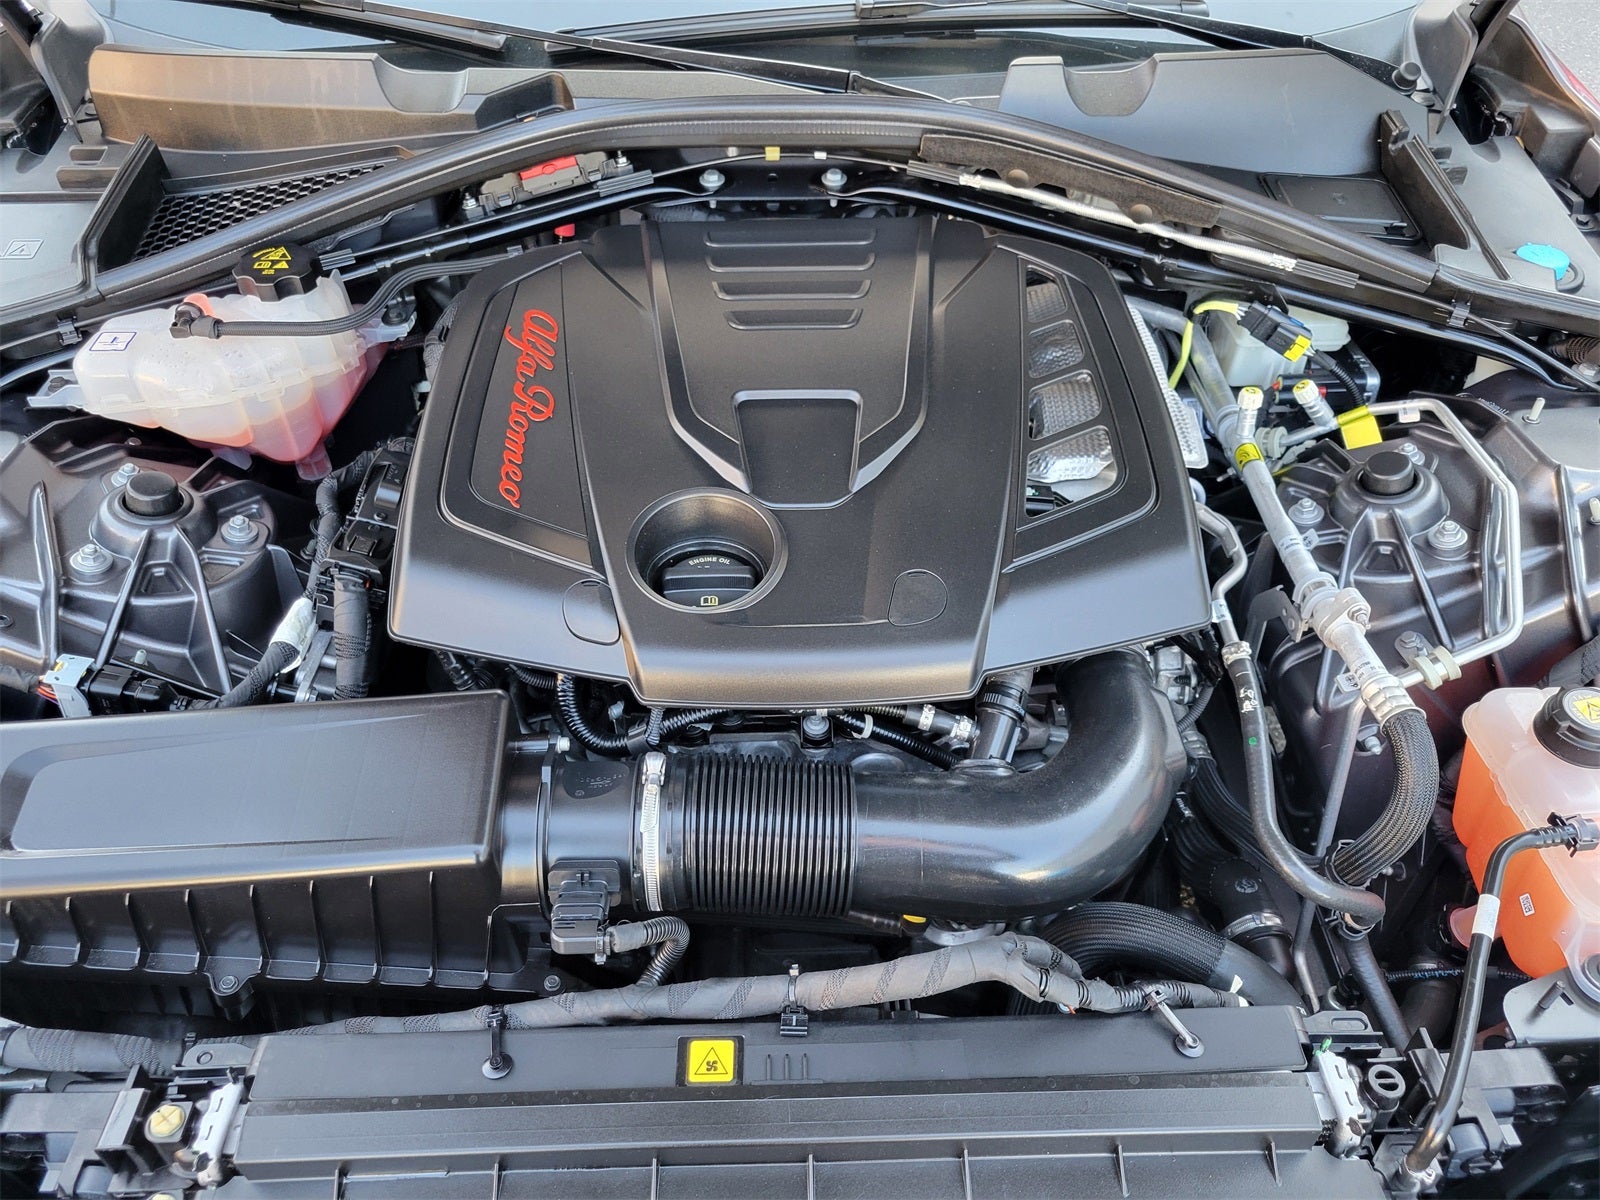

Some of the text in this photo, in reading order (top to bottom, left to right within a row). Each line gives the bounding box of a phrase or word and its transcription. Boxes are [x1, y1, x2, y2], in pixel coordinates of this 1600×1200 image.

[499, 308, 559, 508] Alfa Romeo
[688, 556, 730, 566] ENGINE OIL
